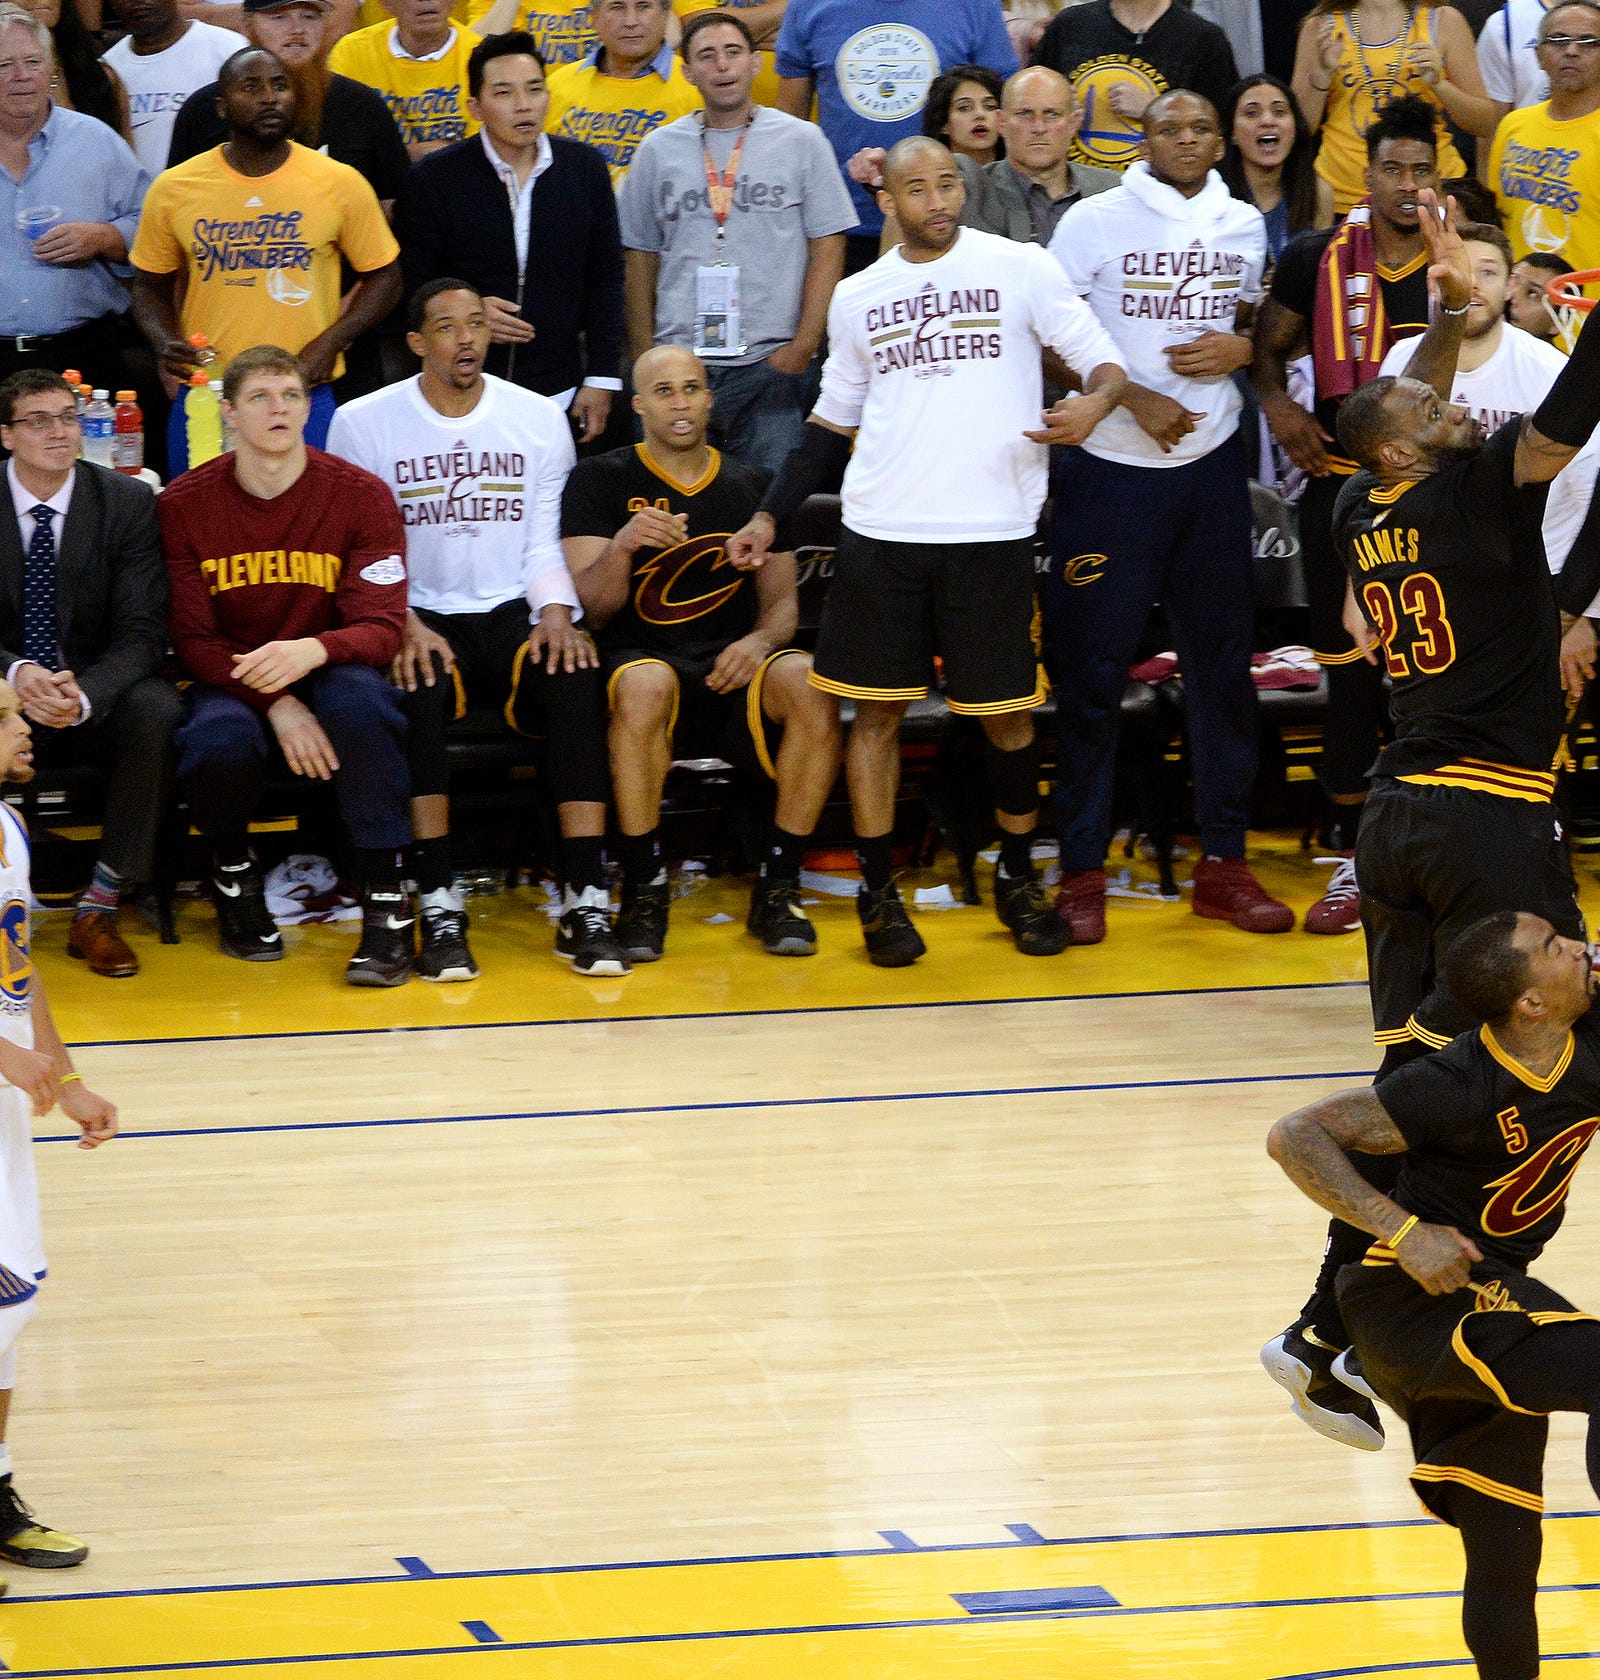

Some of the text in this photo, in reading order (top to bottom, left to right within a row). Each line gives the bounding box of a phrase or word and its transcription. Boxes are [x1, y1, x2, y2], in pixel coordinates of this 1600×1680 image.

[657, 174, 786, 222] Coies
[194, 210, 304, 252] Strength
[867, 289, 1001, 332] CLEVELAND
[874, 333, 1002, 375] CAVALIERS
[395, 451, 525, 484] CLEVELAND
[400, 498, 524, 527] CAVALIERS
[1353, 527, 1420, 572] JAMES
[1363, 571, 1457, 678] 23
[1496, 1105, 1529, 1155] 5
